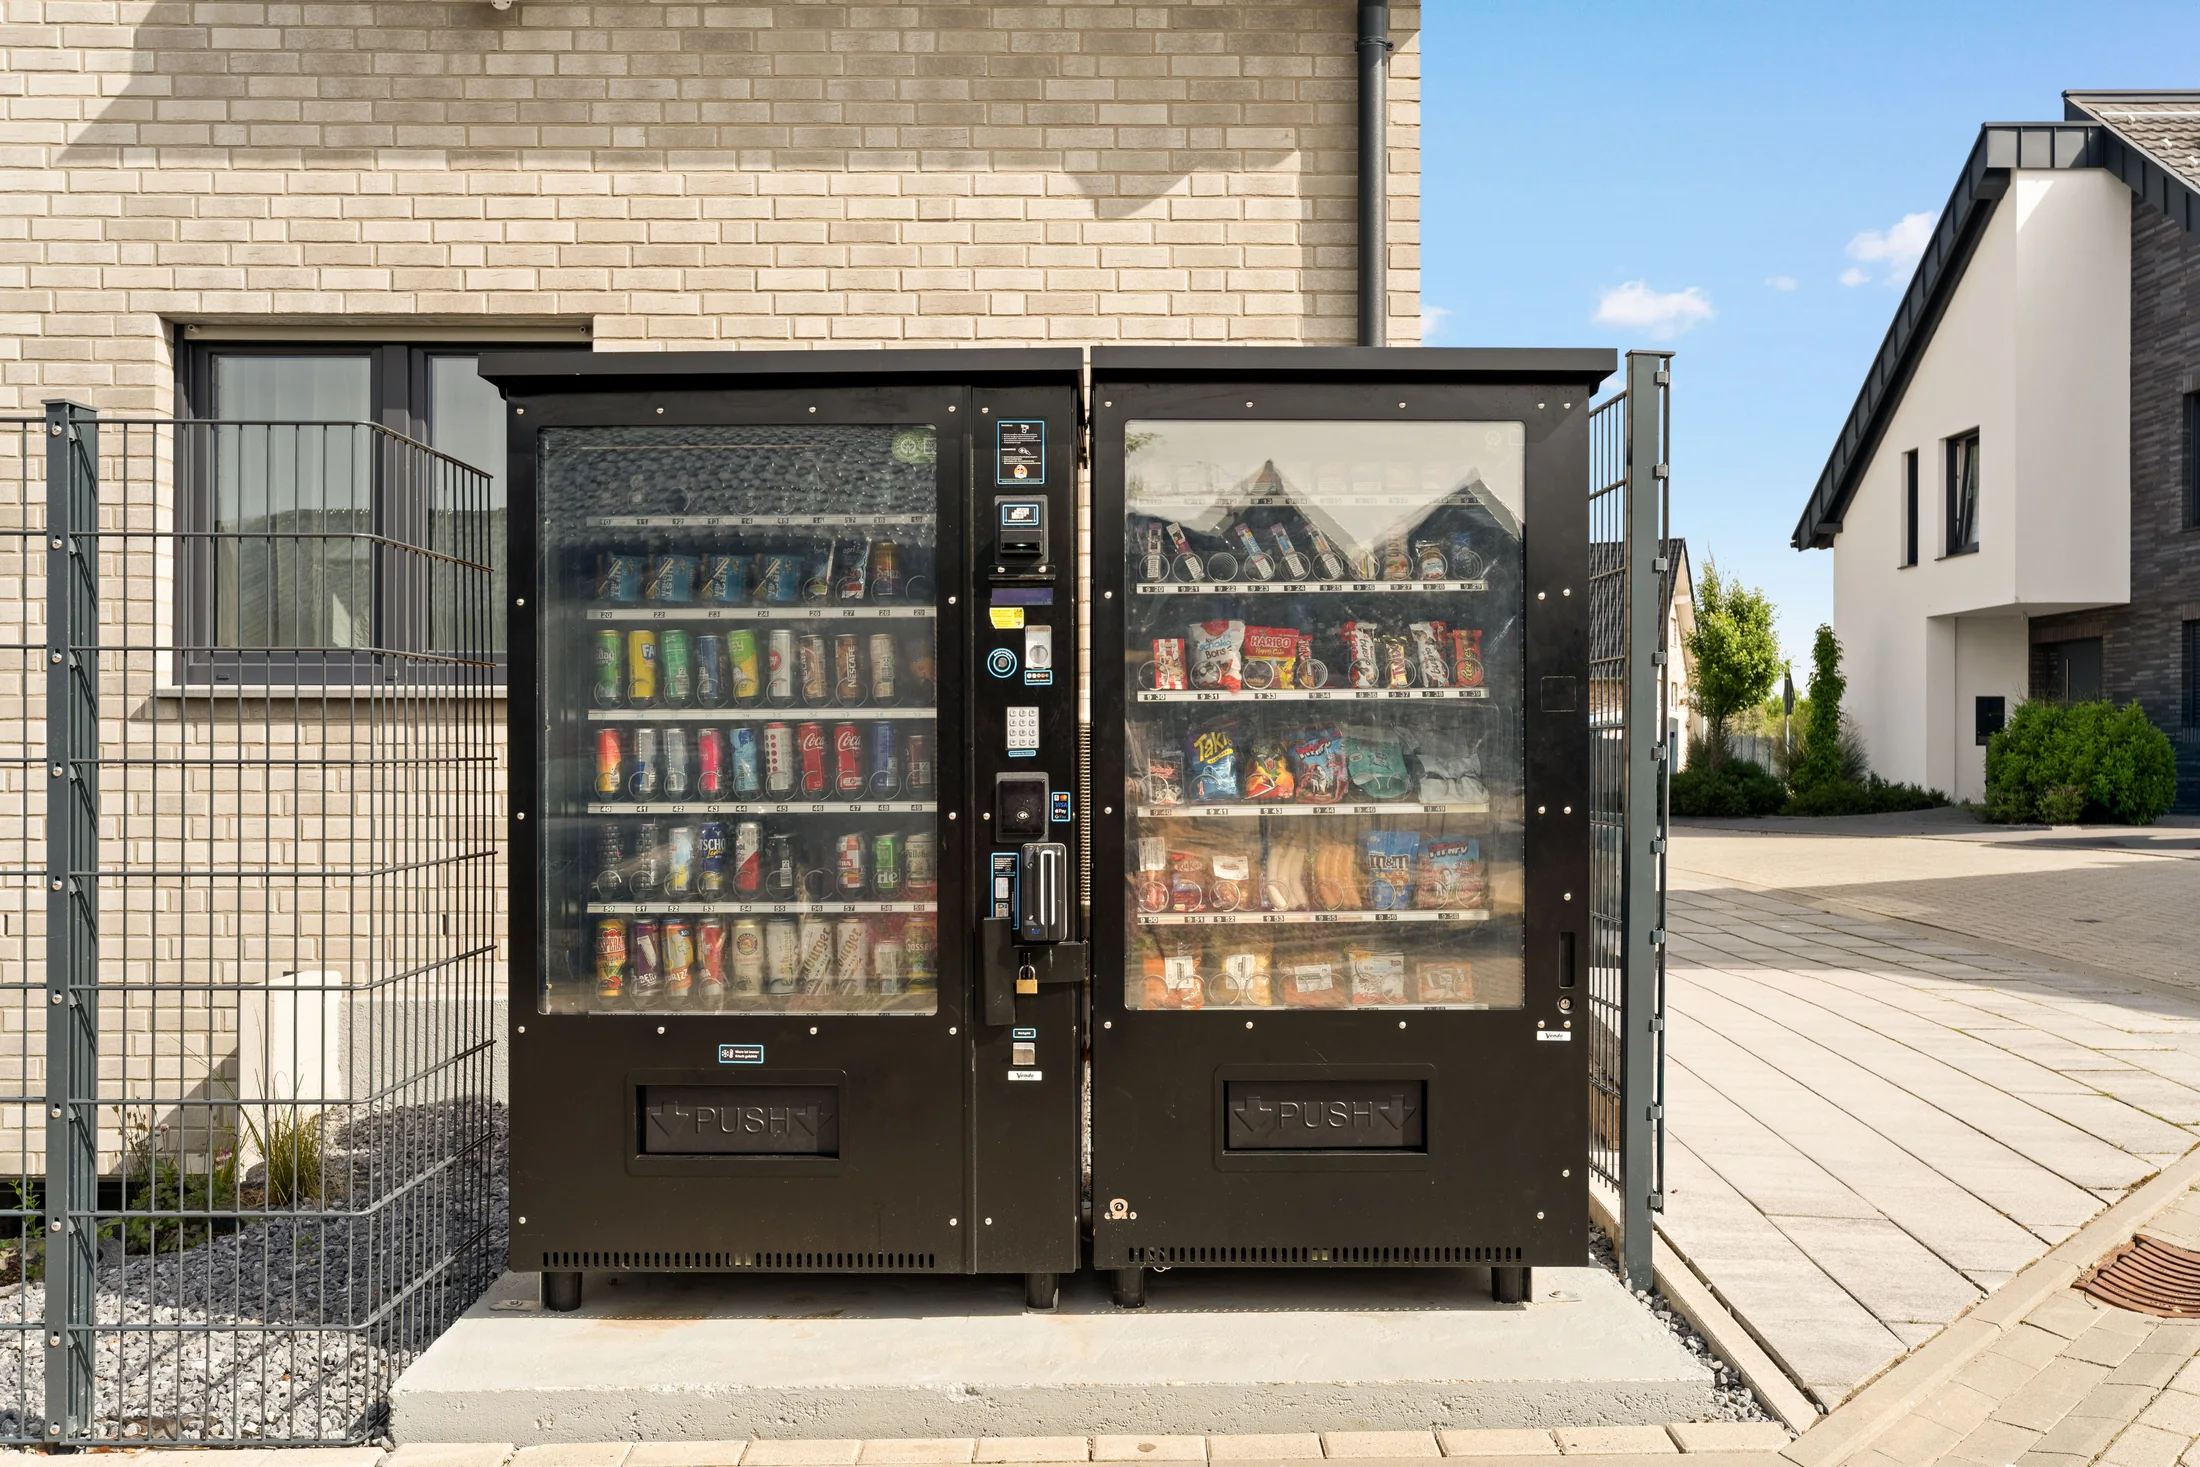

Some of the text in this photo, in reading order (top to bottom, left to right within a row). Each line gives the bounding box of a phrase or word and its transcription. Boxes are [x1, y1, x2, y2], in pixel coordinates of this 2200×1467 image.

[1251, 636, 1291, 649] HARIBO
[838, 731, 861, 752] Coca
[696, 1107, 789, 1134] PUSH
[1279, 1101, 1373, 1128] PUSH
